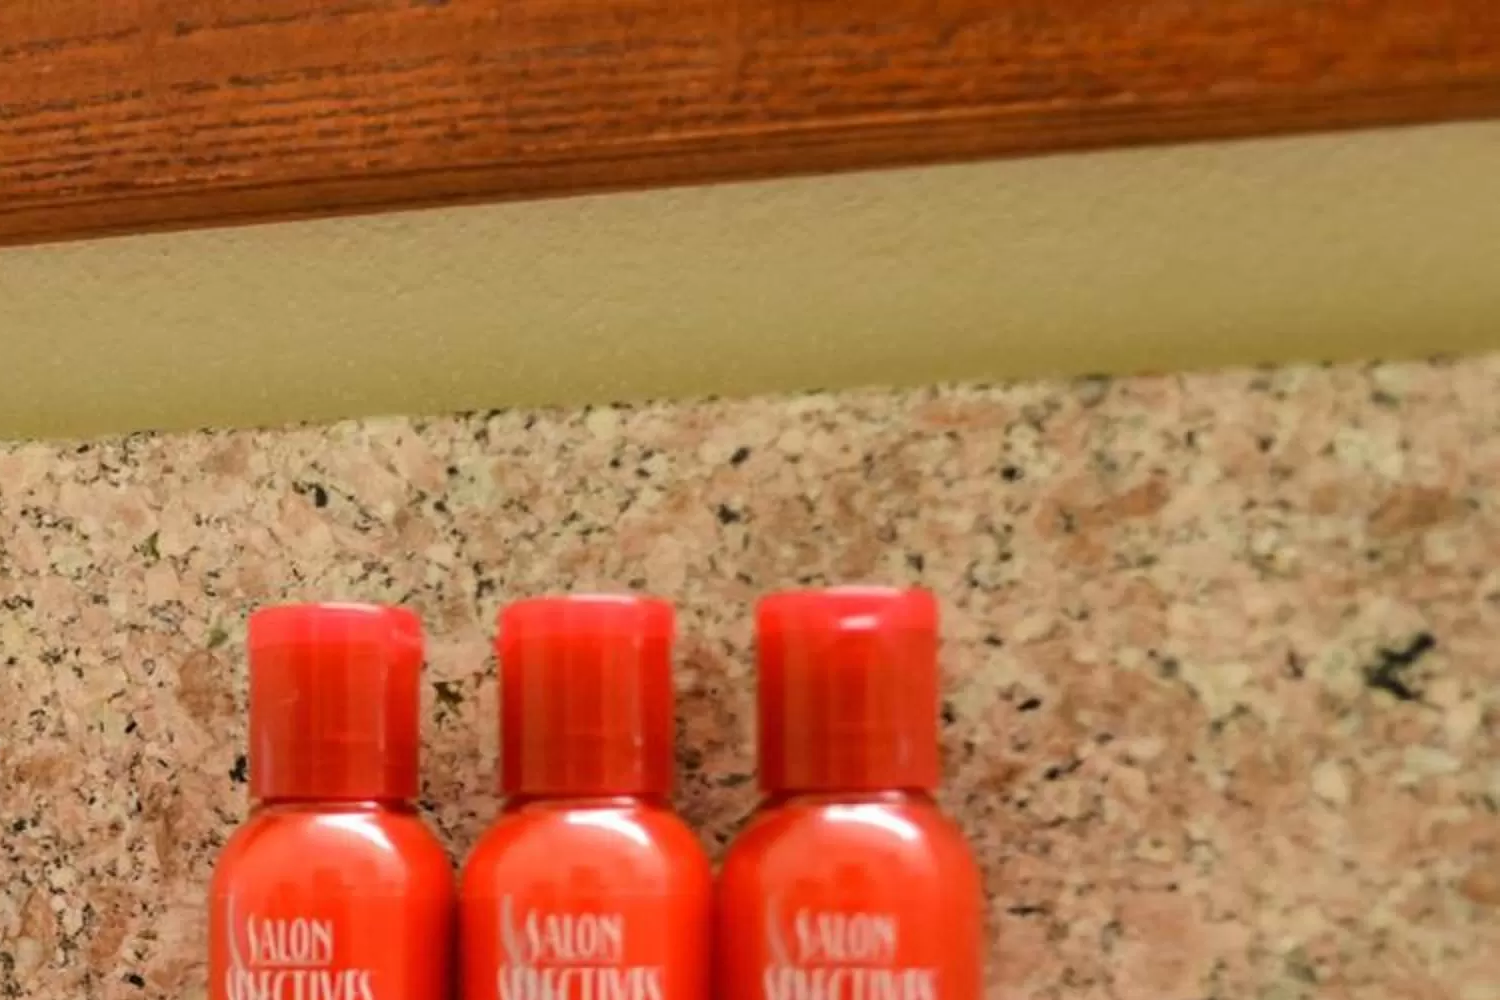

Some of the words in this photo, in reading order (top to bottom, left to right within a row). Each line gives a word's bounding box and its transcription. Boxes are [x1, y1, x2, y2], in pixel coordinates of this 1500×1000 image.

[247, 913, 334, 966] SALON
[525, 908, 623, 964] SALON
[795, 908, 897, 964] SALON
